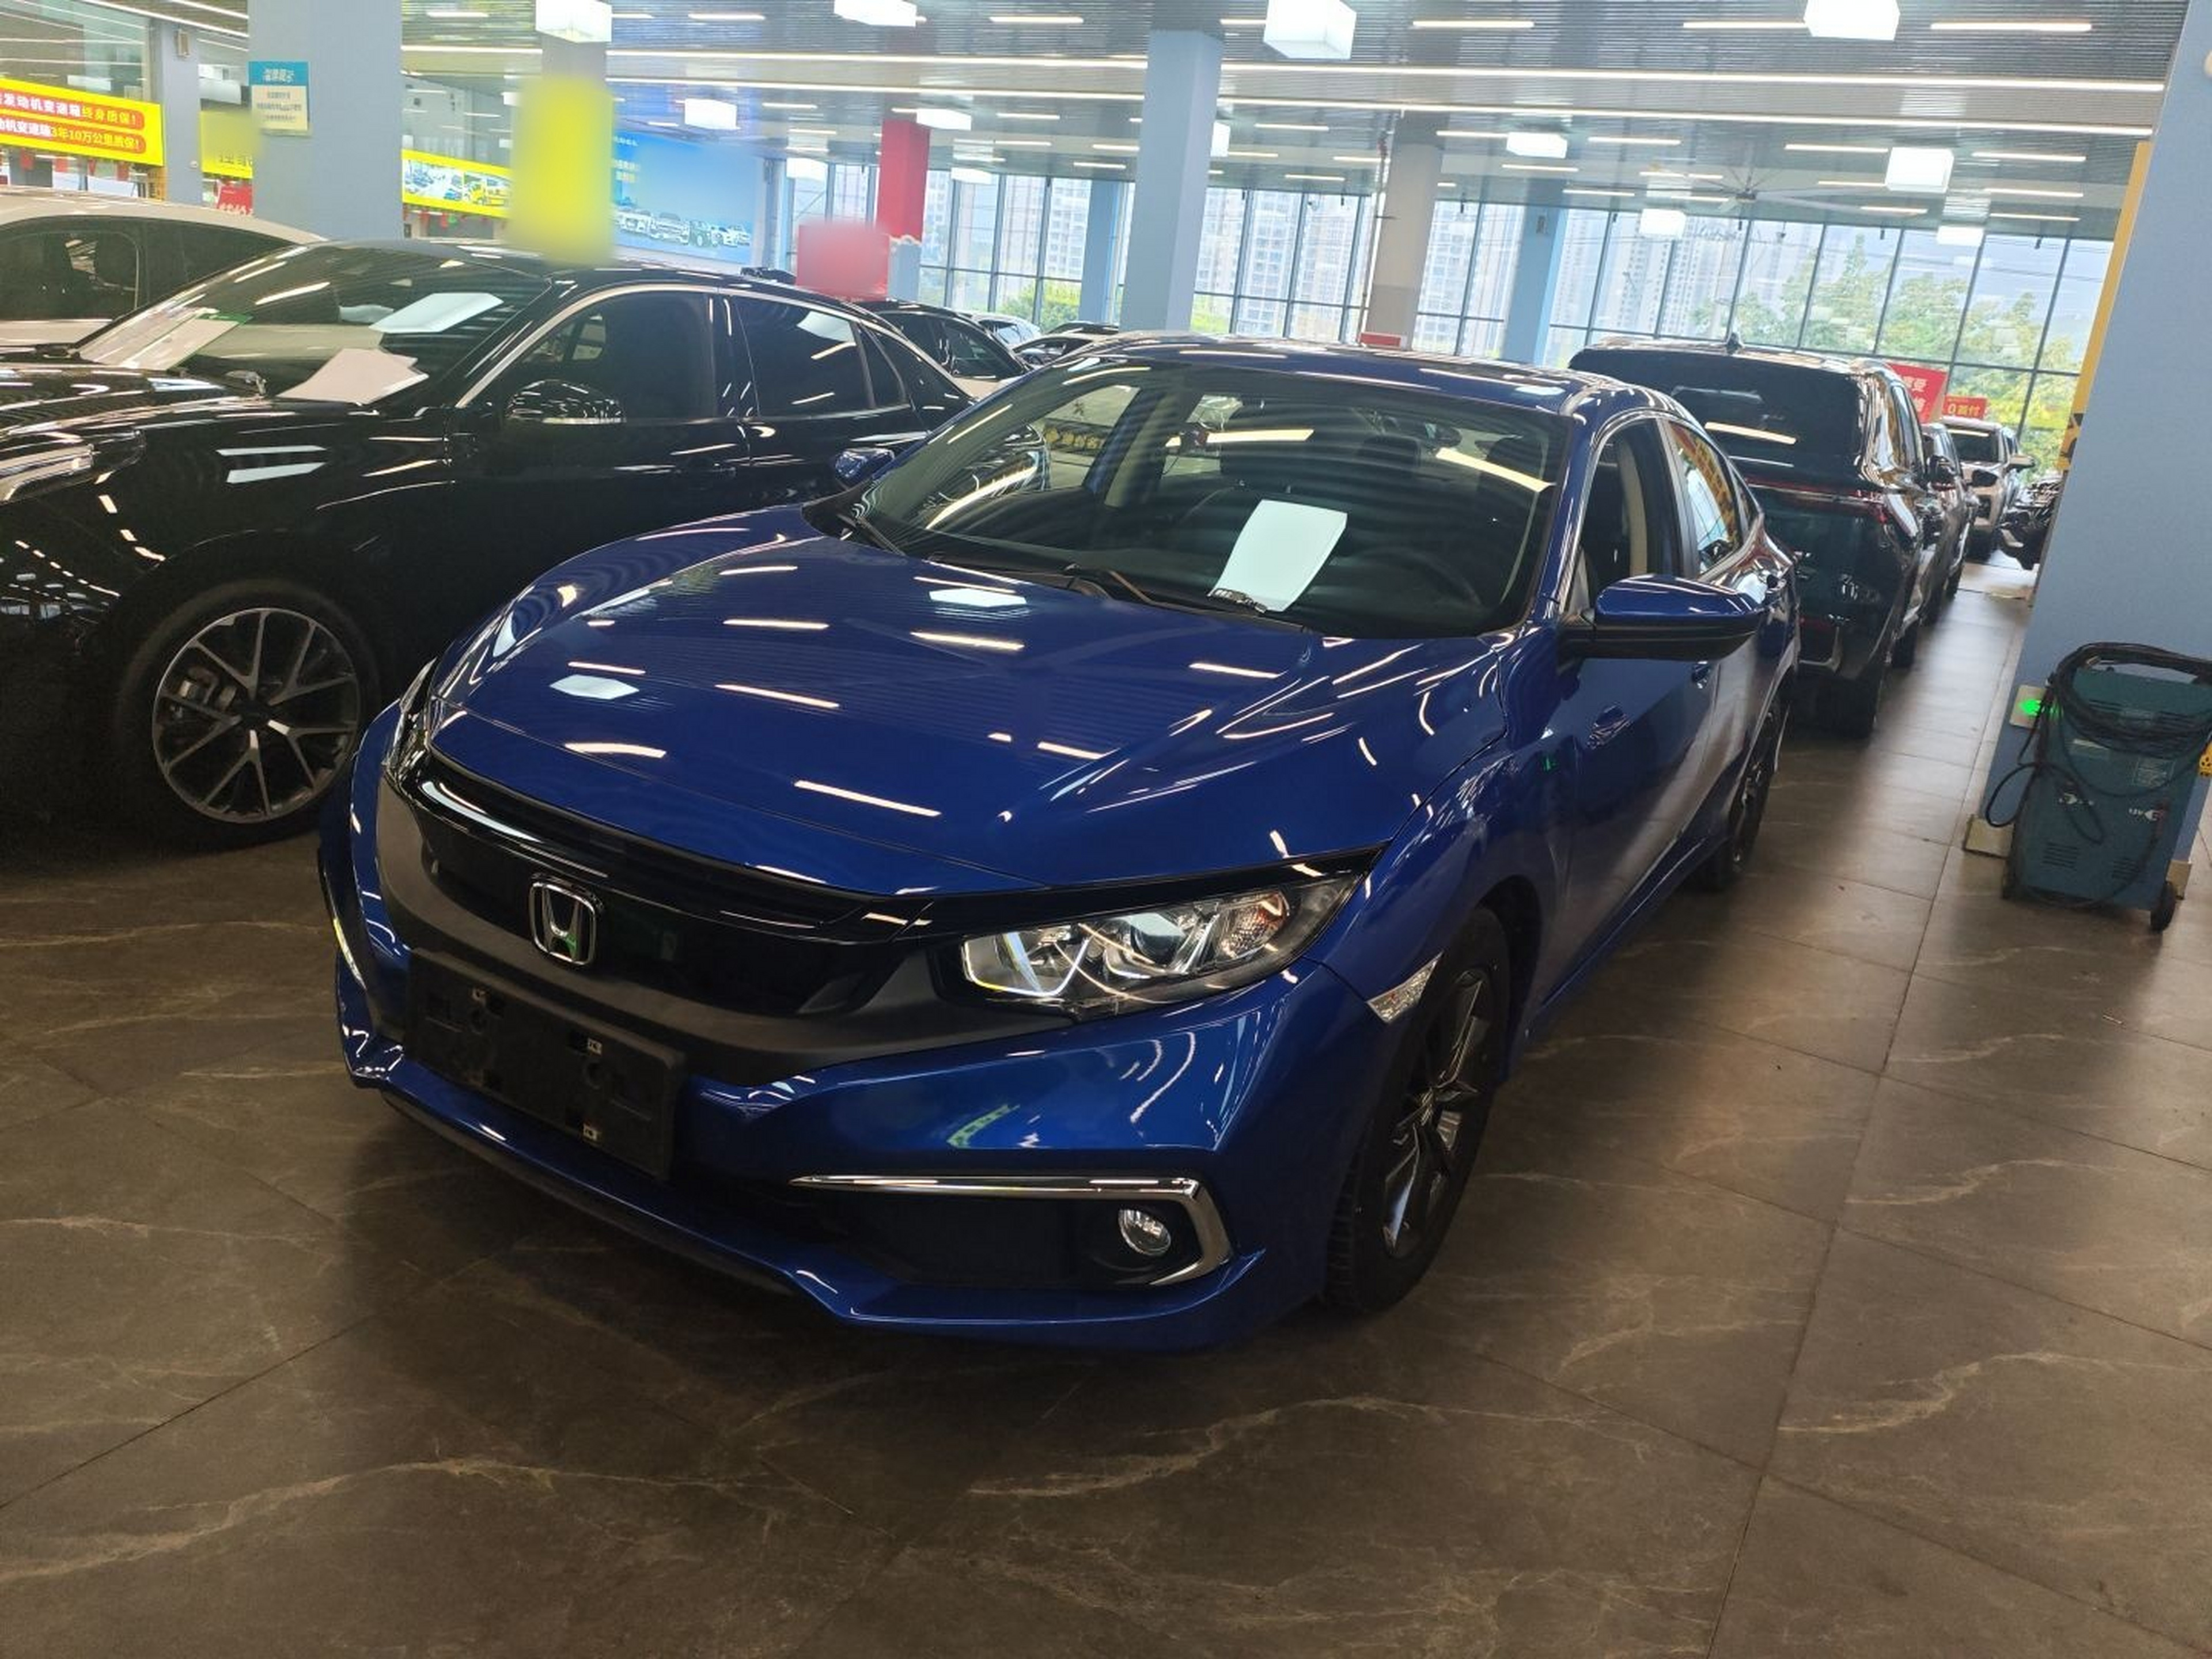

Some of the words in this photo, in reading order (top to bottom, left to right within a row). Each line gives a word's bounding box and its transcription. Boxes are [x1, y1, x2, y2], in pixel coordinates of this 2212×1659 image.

[0, 92, 136, 124] 发动机变速箱终身质保!
